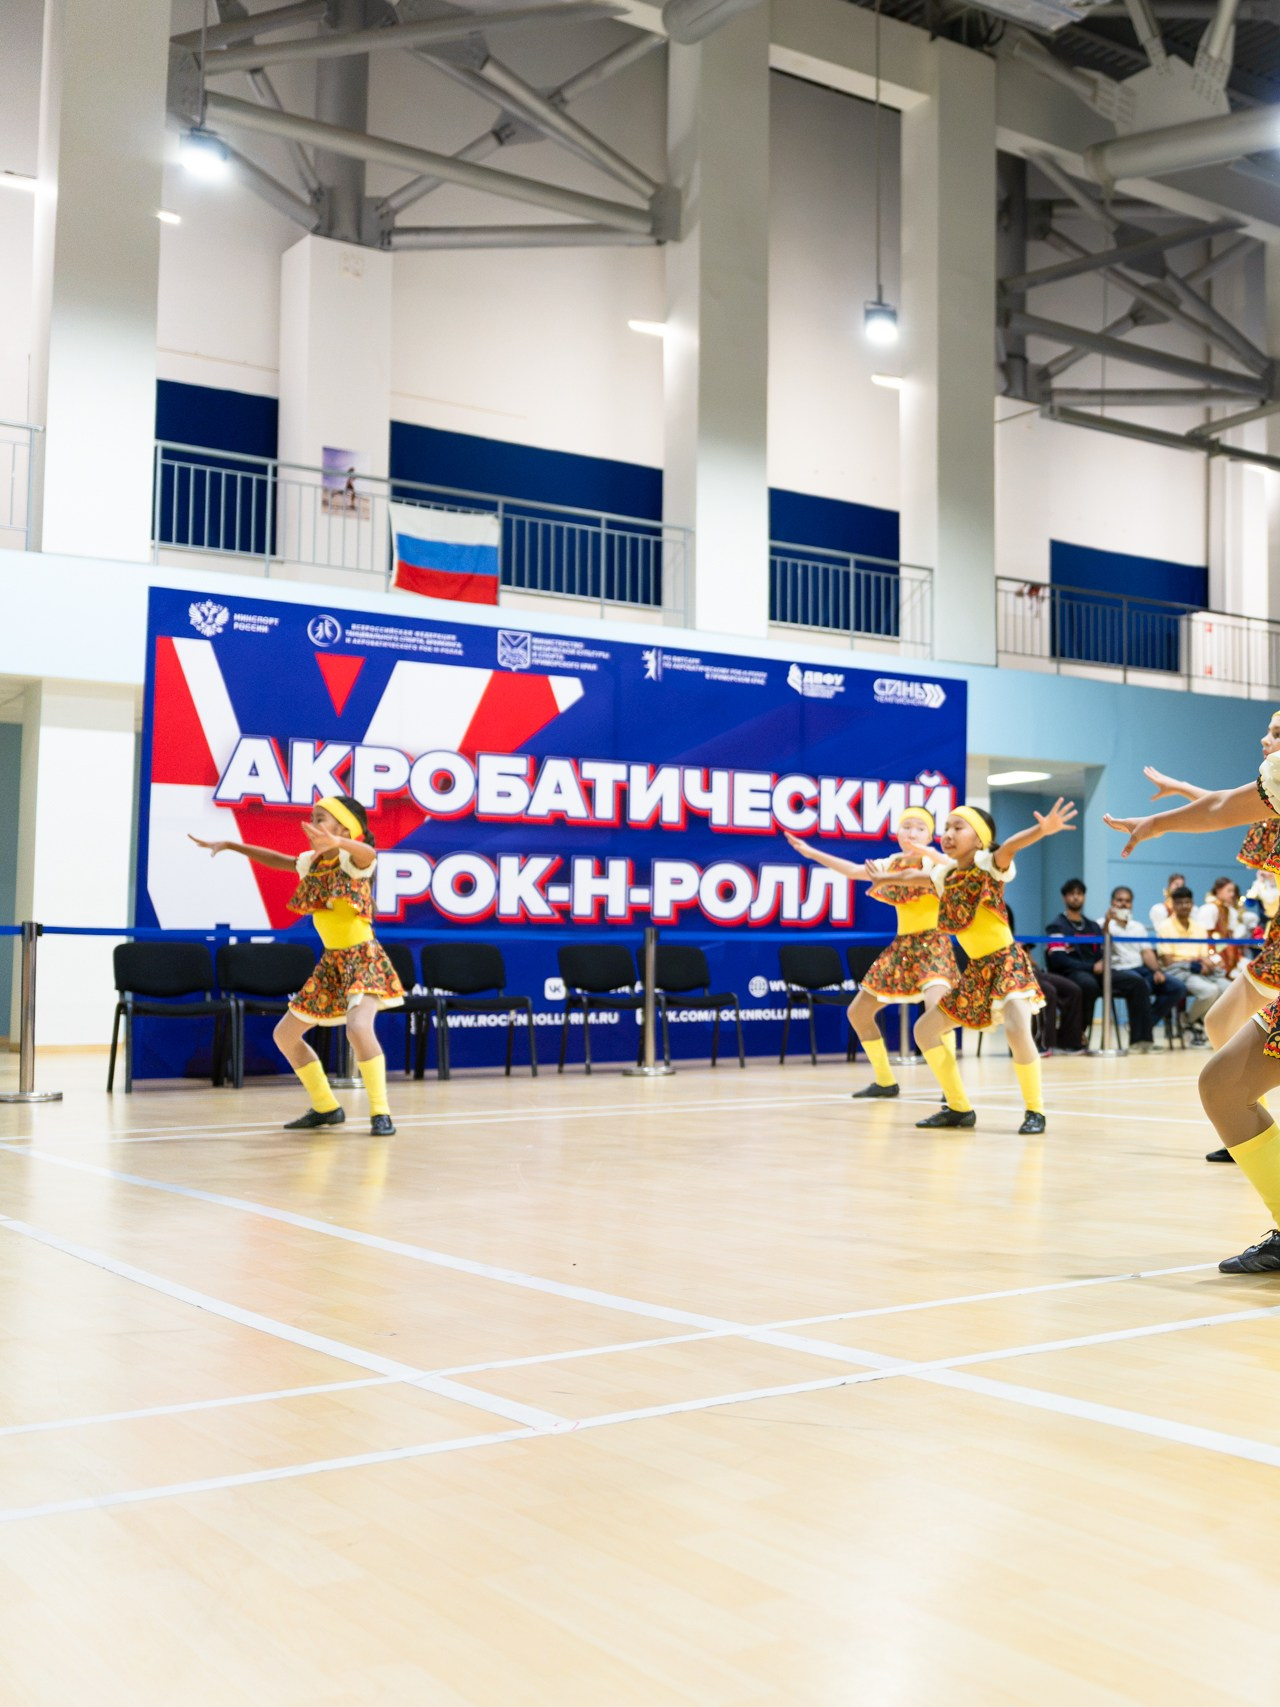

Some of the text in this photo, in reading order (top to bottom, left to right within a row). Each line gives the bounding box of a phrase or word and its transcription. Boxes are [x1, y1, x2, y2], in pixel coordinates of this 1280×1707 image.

[233, 612, 280, 627] МИНСПОРТ
[233, 621, 269, 634] РОССИИ
[804, 670, 845, 686] ДВФУ
[873, 678, 928, 701] СТАНЬ
[213, 733, 957, 843] АКРОБАТИЧЕСКИЙ
[374, 848, 856, 927] РОК-Н-РОЛЛ
